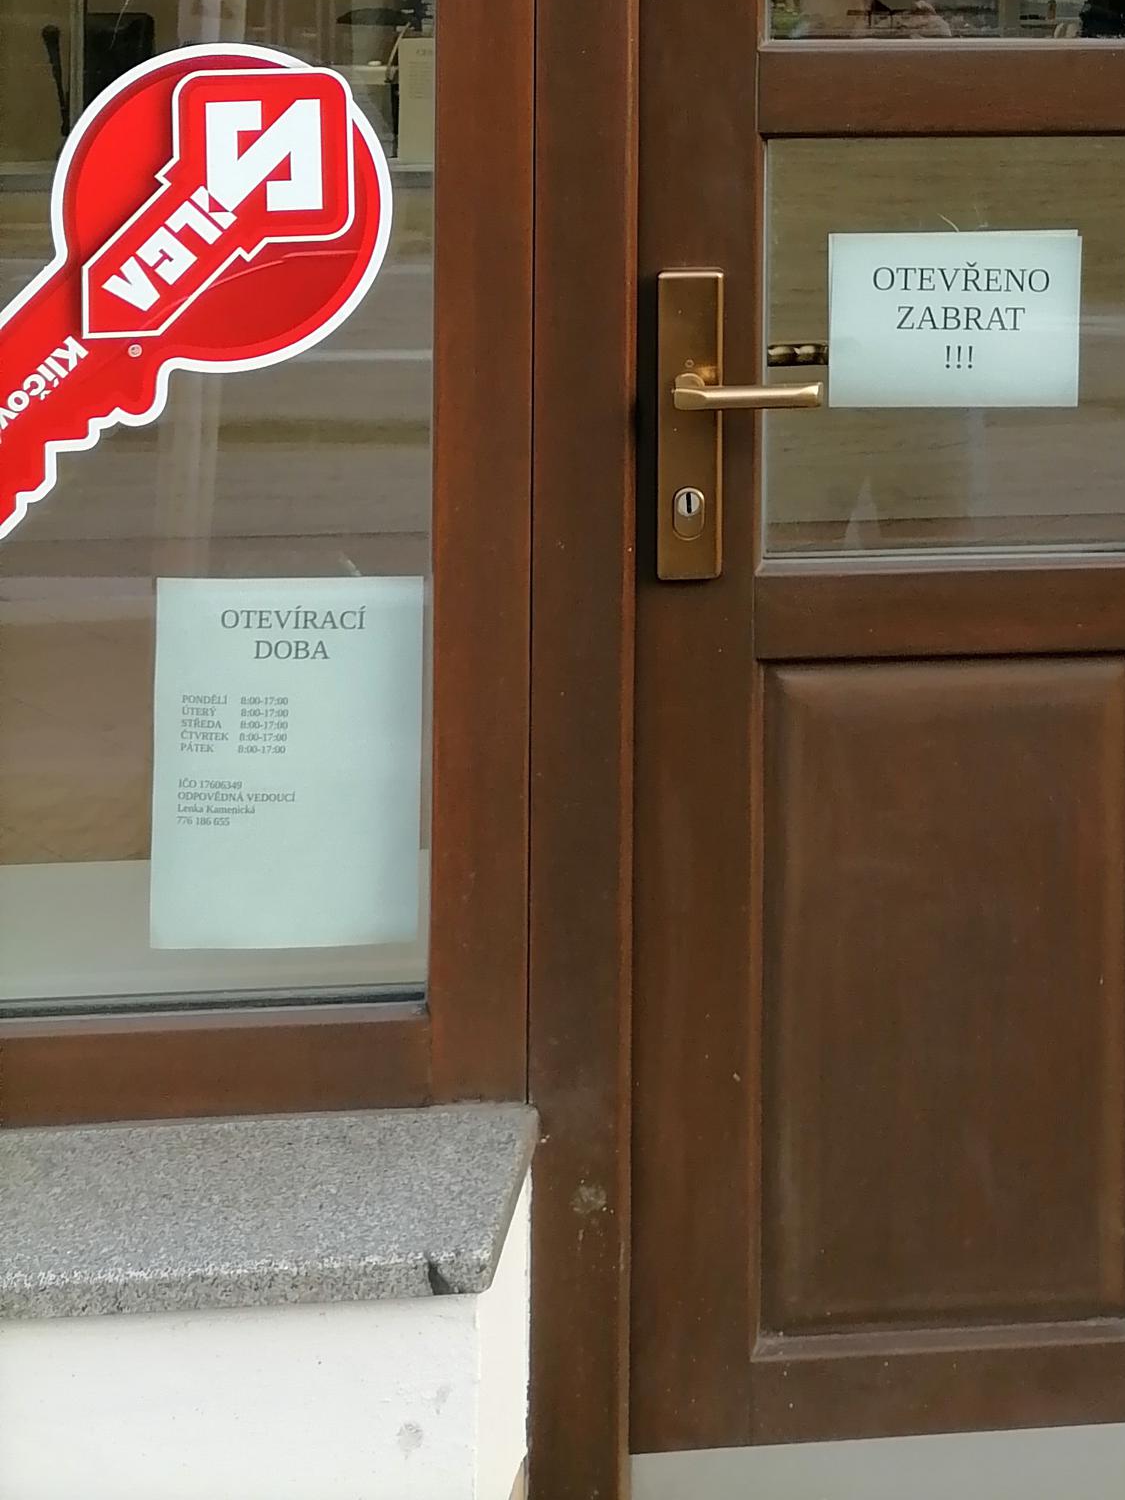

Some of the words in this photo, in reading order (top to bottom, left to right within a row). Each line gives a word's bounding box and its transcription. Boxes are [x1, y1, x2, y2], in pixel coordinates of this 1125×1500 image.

[102, 98, 324, 312] SILCA
[872, 261, 1050, 293] OTEVŘENO
[895, 306, 1026, 332] ZABRAT
[945, 345, 974, 369] !!!
[0, 335, 89, 441] Klíčov
[220, 605, 366, 630] OTEVÍRACÍ
[253, 640, 330, 660] DOBA
[181, 693, 228, 705] PONDĚLÍ
[240, 696, 289, 706] 8:00-17:00
[181, 704, 217, 717] ÚTERÝ
[240, 708, 289, 718] 8:00-17:00
[180, 717, 222, 729] STŘEDA
[240, 720, 289, 730] 8:00-17:00
[180, 729, 229, 741] ČTVRTEK
[180, 740, 214, 753] PÁTEK
[178, 777, 197, 789] IČO
[177, 790, 244, 802] ODPOVĚDNÁ
[246, 790, 296, 803] VEDOUCÍ
[177, 803, 204, 813] Lenka
